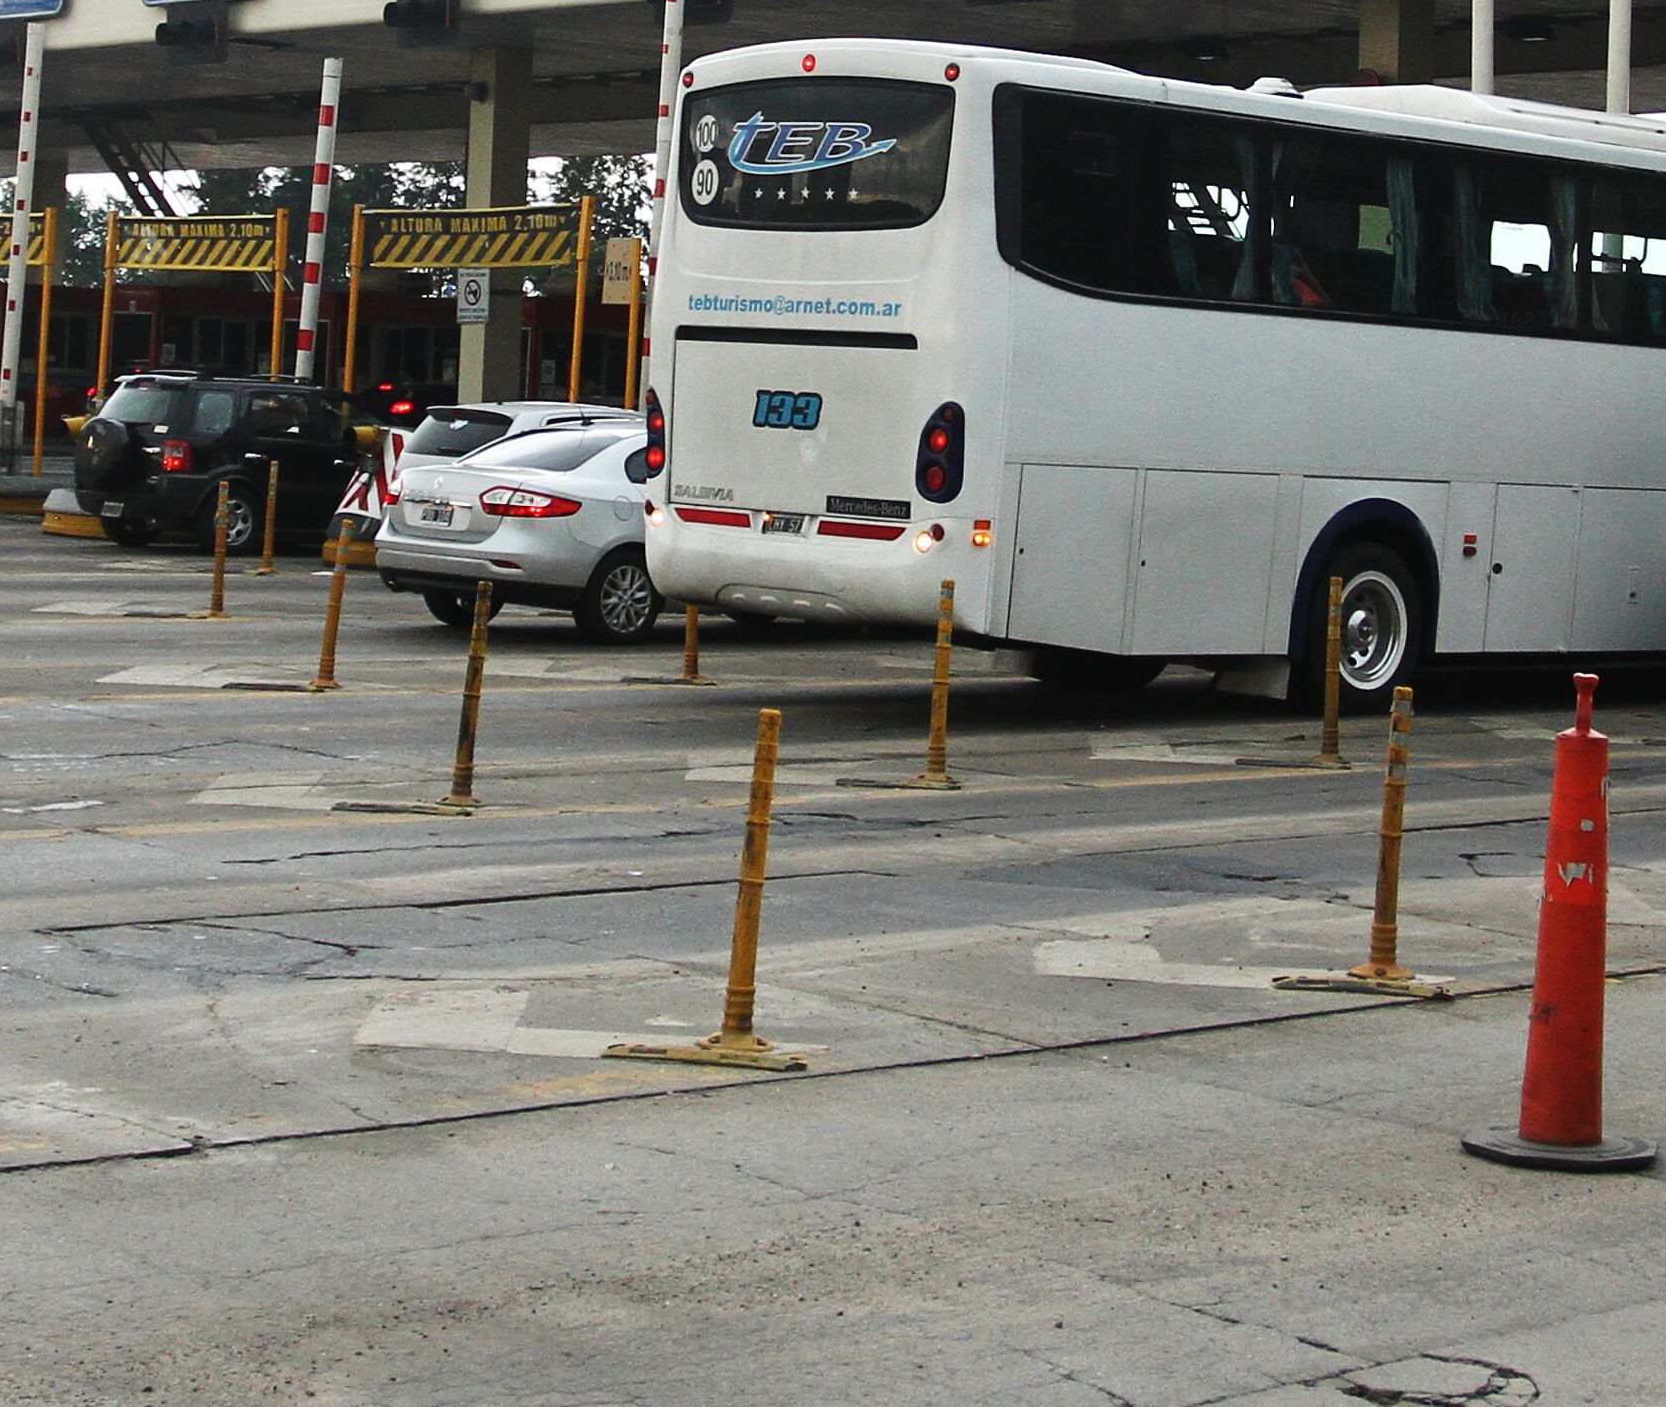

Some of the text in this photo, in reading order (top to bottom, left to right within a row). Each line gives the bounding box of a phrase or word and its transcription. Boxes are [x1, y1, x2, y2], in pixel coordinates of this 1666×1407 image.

[698, 122, 717, 149] 100
[697, 168, 713, 195] 90
[390, 217, 443, 233] ALTURA
[450, 216, 507, 233] MAXIMA
[688, 294, 902, 317] tebturismo@arnet.com.ar
[753, 389, 823, 430] 133
[830, 497, 907, 516] Mercedes-Benz
